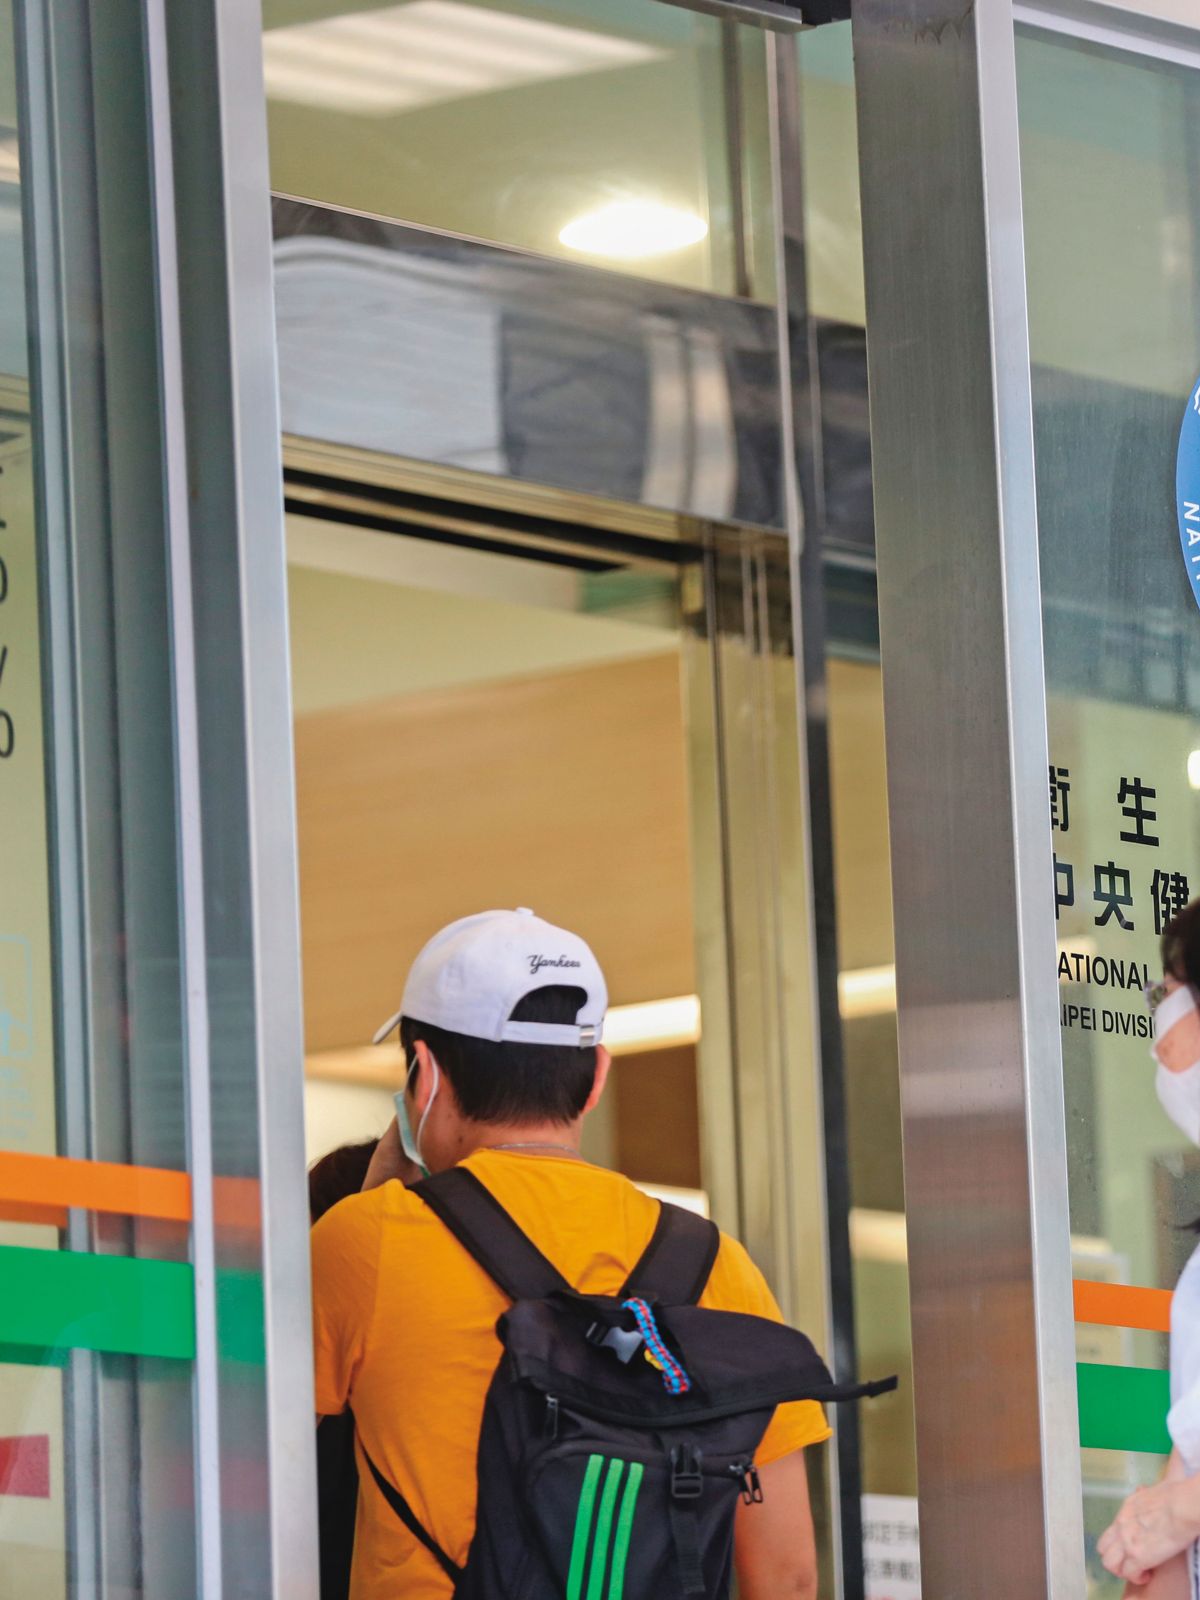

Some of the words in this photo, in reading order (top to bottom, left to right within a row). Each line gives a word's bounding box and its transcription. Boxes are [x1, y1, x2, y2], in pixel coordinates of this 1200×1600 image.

[527, 954, 581, 974] Yankees
[1058, 951, 1149, 991] ATIONA
[1060, 1004, 1097, 1031] IPEI
[1102, 1009, 1154, 1039] DIVISI
